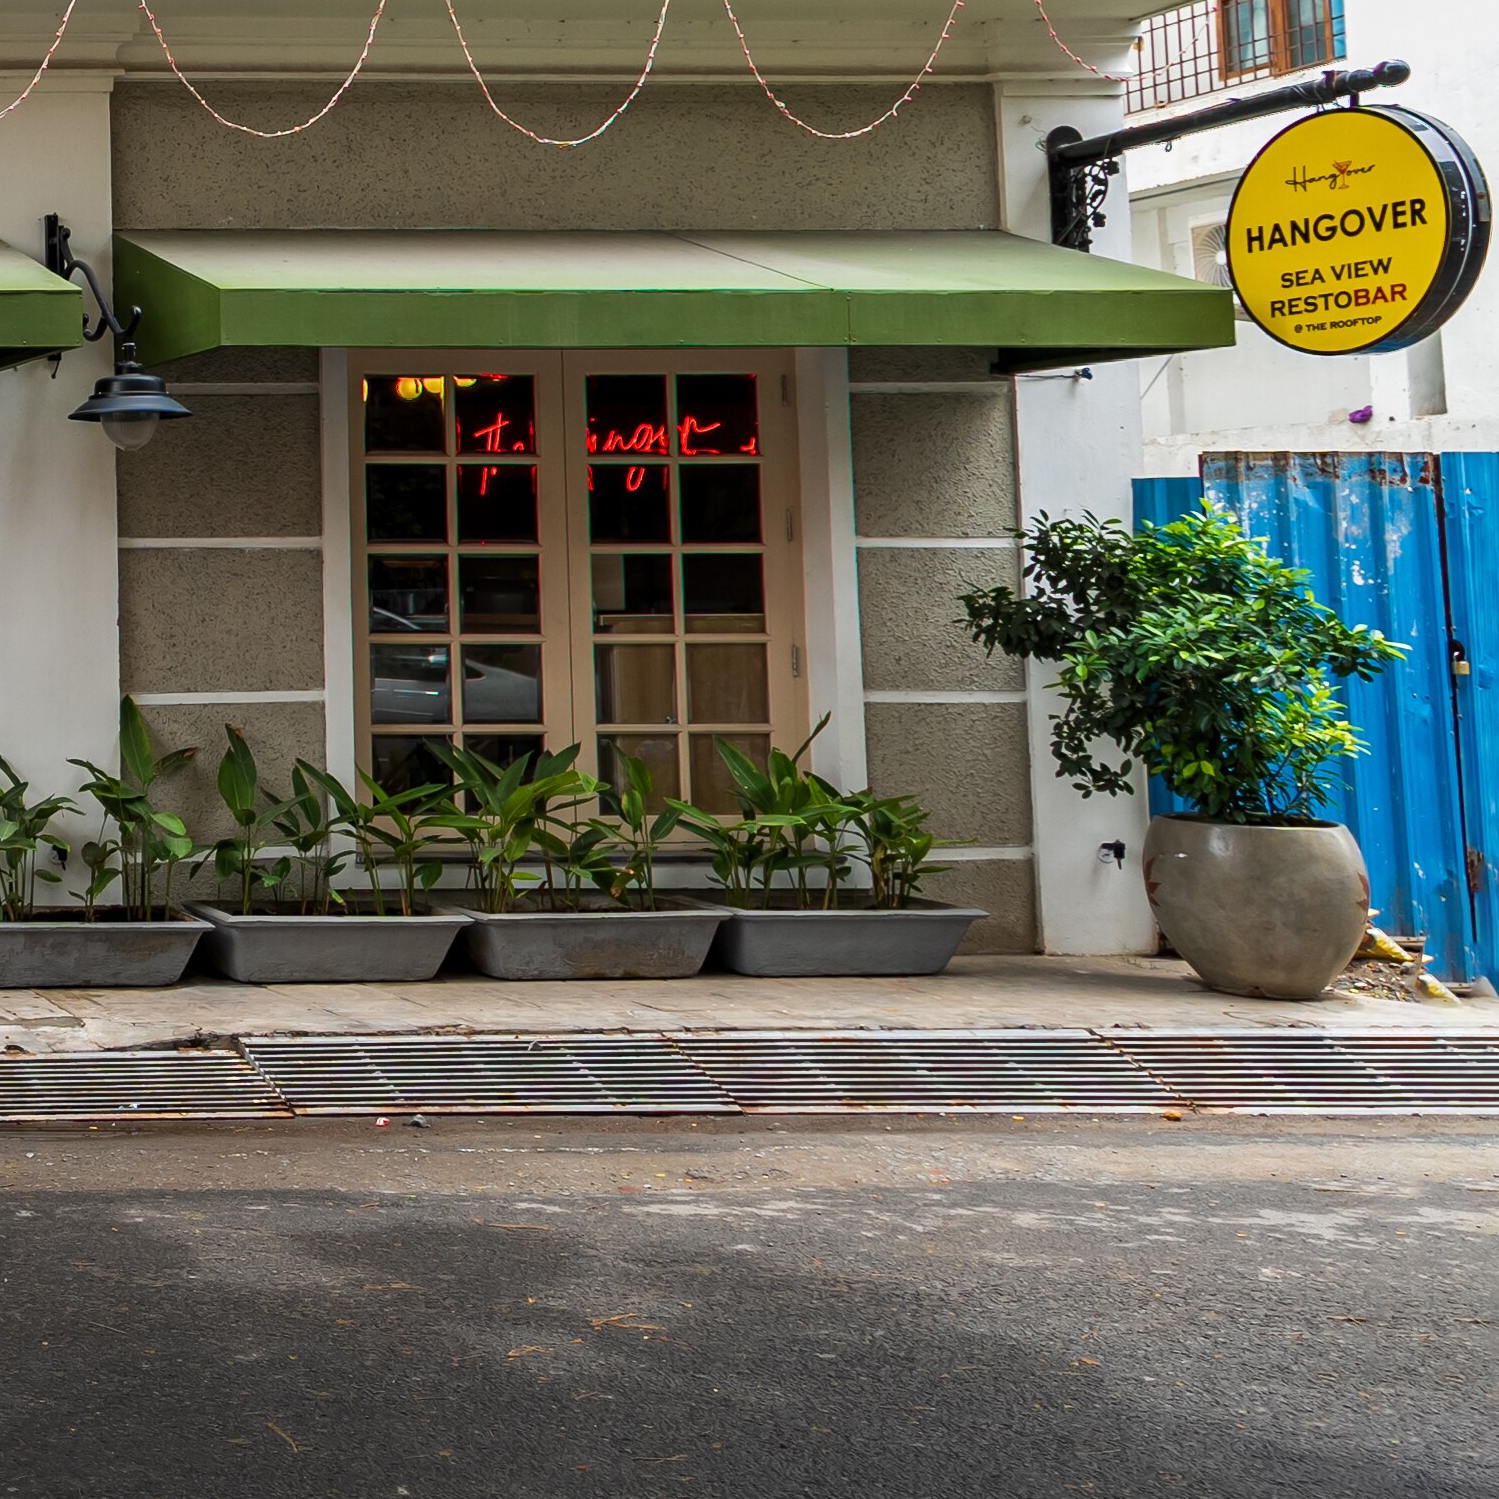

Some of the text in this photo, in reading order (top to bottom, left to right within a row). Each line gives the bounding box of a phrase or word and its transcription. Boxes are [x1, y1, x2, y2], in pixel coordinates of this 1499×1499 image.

[1246, 198, 1427, 253] HANGOVER
[1281, 257, 1392, 289] SEA VIEW
[1270, 283, 1407, 318] RESTOBAR
[1294, 316, 1382, 333] @ THE ROOFTOP
